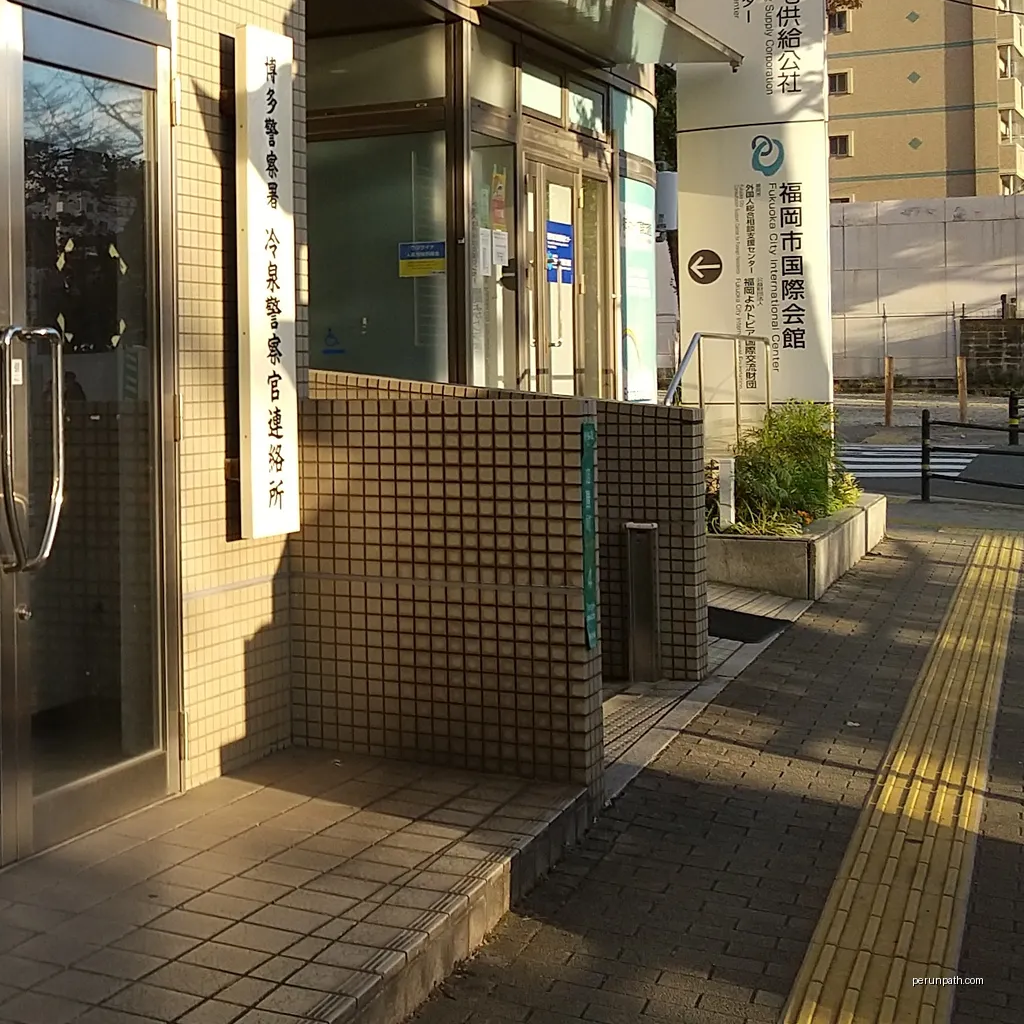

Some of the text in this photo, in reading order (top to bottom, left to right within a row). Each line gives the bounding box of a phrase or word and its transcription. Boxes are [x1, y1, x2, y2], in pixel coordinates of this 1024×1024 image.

[764, 4, 775, 37] Supply
[765, 39, 775, 96] Corporation
[264, 56, 285, 510] 博多警察署 冷泉警察官連絡所
[768, 182, 781, 373] Fukuoka City International Center
[779, 182, 806, 349] 福岡市国際会館
